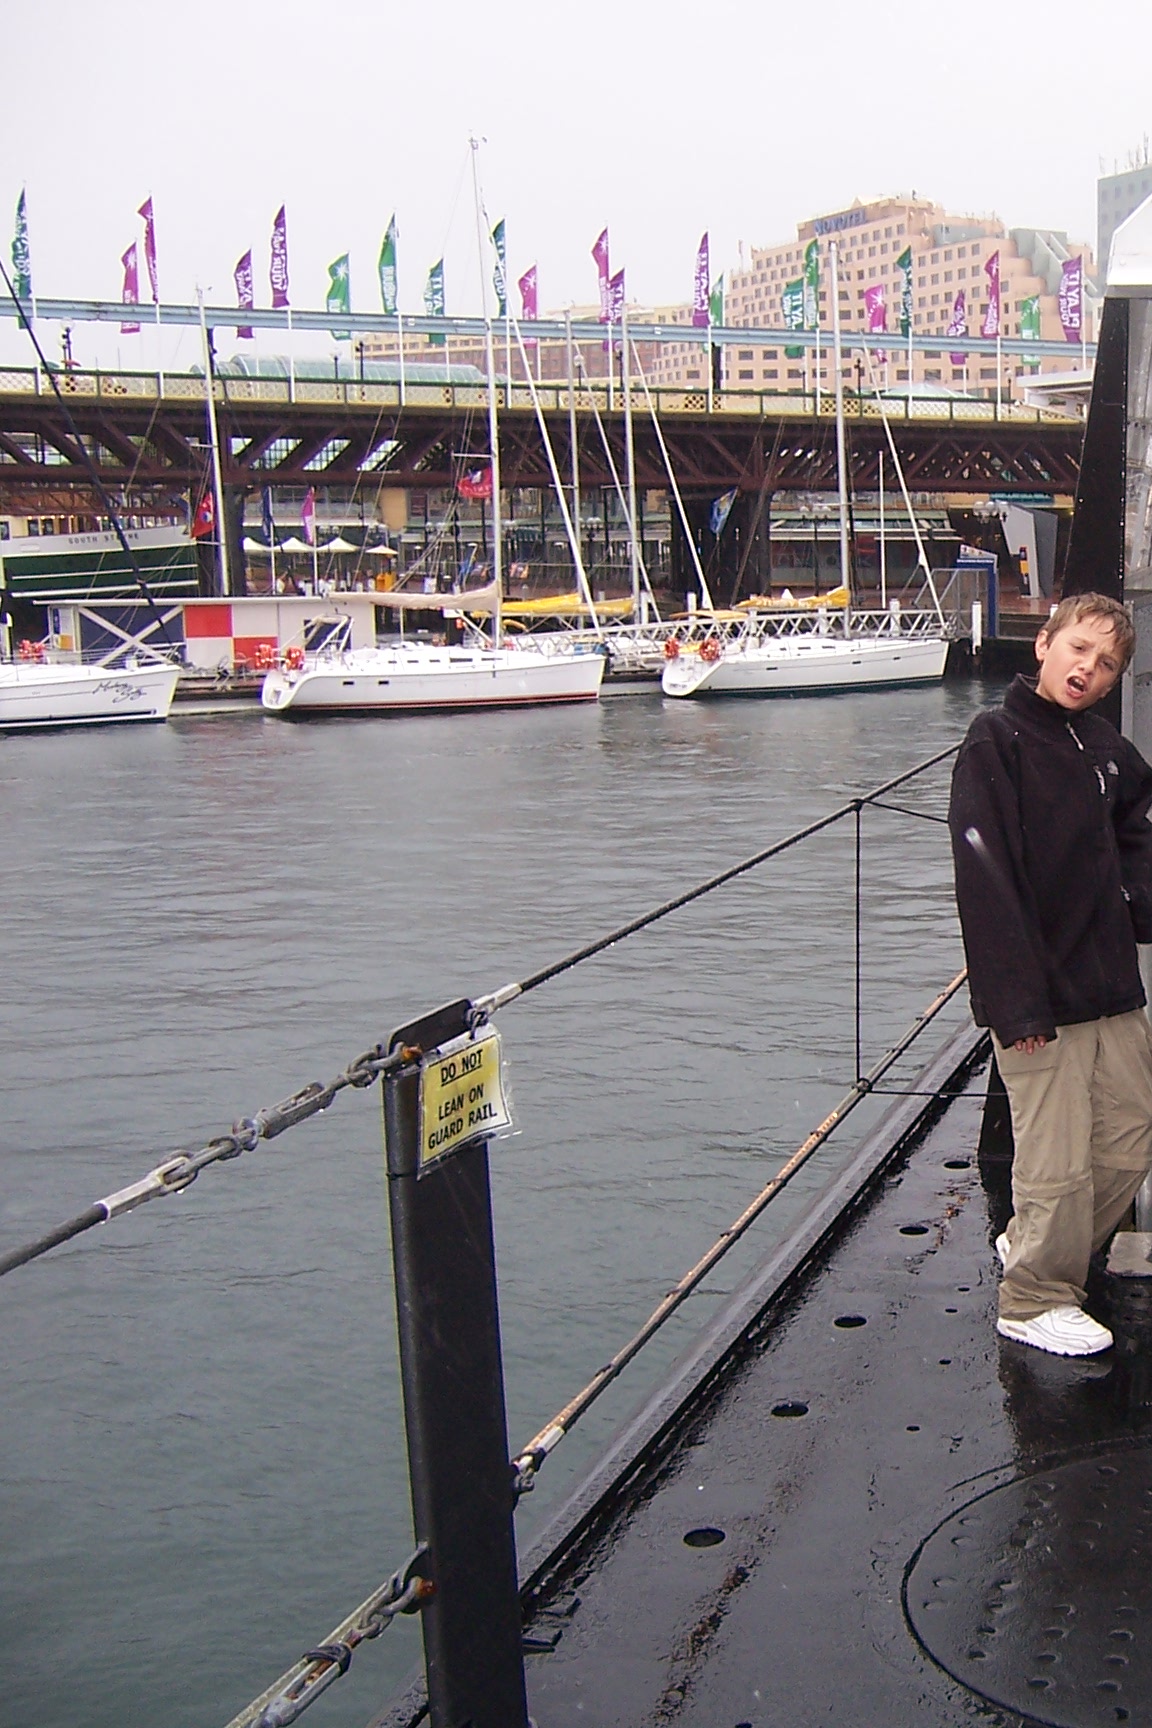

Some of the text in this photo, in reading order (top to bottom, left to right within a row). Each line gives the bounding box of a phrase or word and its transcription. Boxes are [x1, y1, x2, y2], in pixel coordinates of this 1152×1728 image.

[441, 1049, 483, 1083] DO NOT
[438, 1083, 484, 1121] LEAN ON
[428, 1102, 498, 1150] GUARD RAIL
